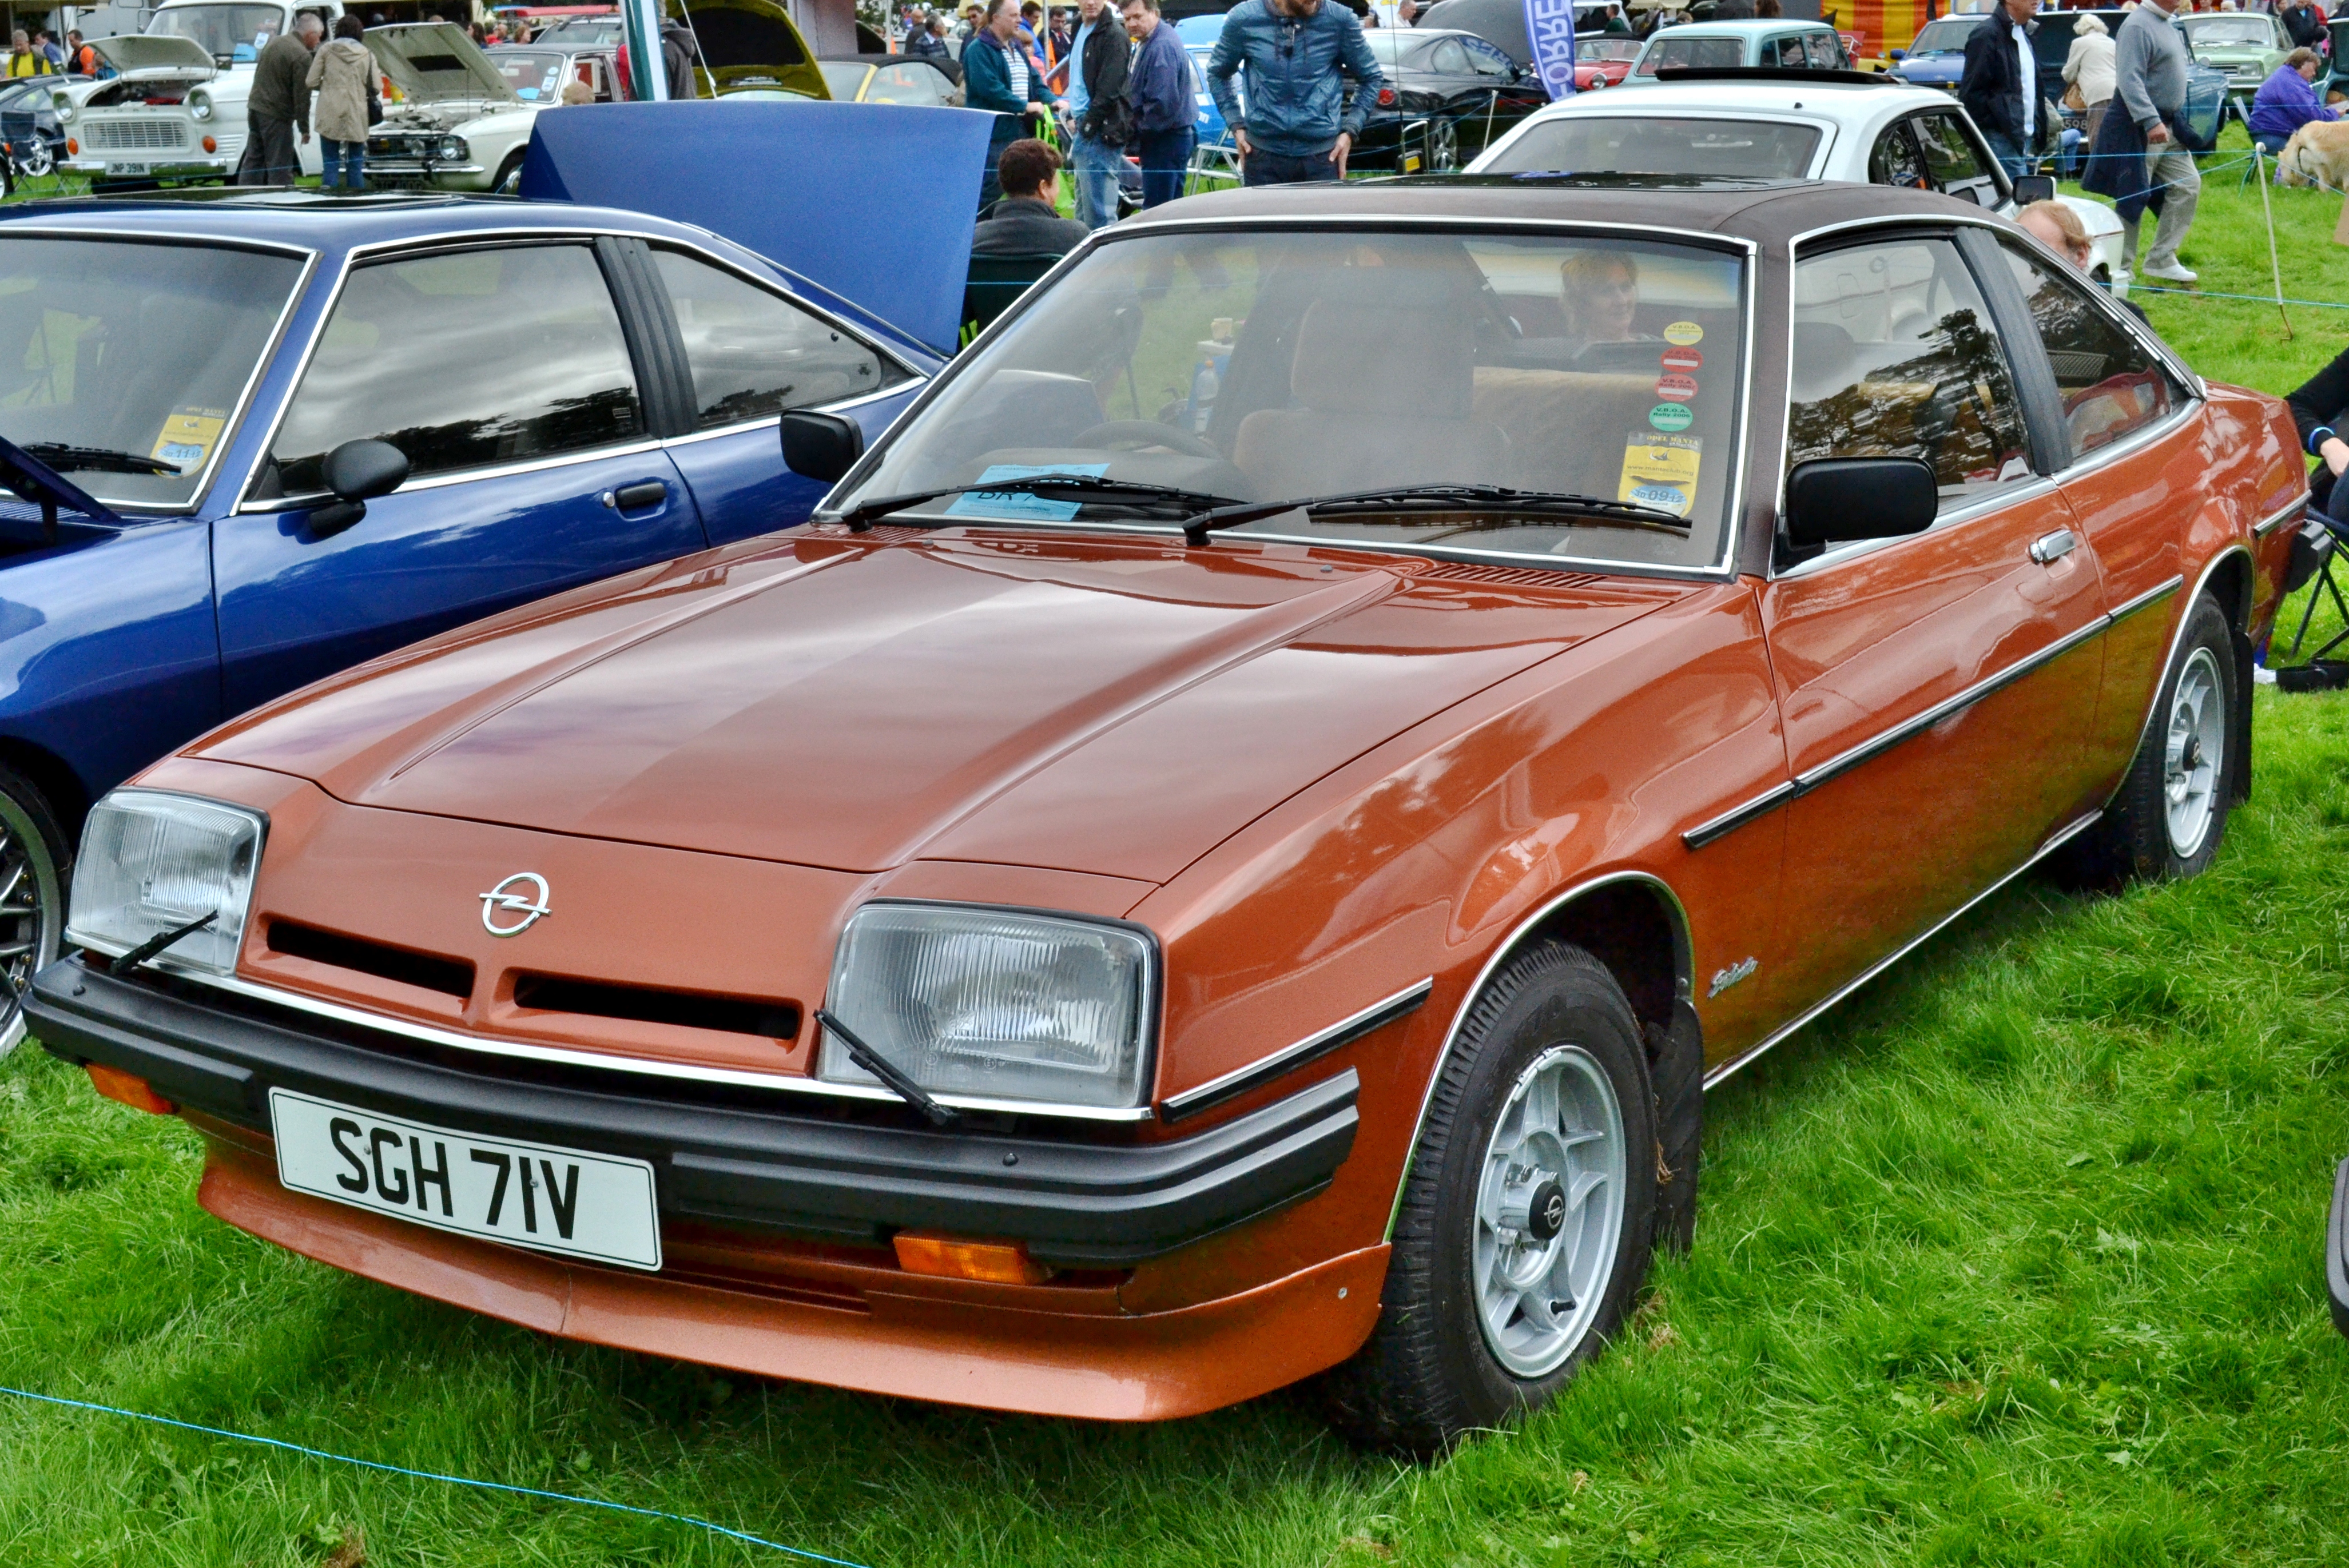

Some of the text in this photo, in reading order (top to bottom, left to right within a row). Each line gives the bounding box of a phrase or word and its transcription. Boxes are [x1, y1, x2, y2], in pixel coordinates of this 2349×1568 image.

[111, 163, 124, 173] JNP
[1627, 465, 1694, 476] www.mantaclub.org
[1648, 489, 1670, 502] 09
[329, 1116, 579, 1240] SGH 71V
